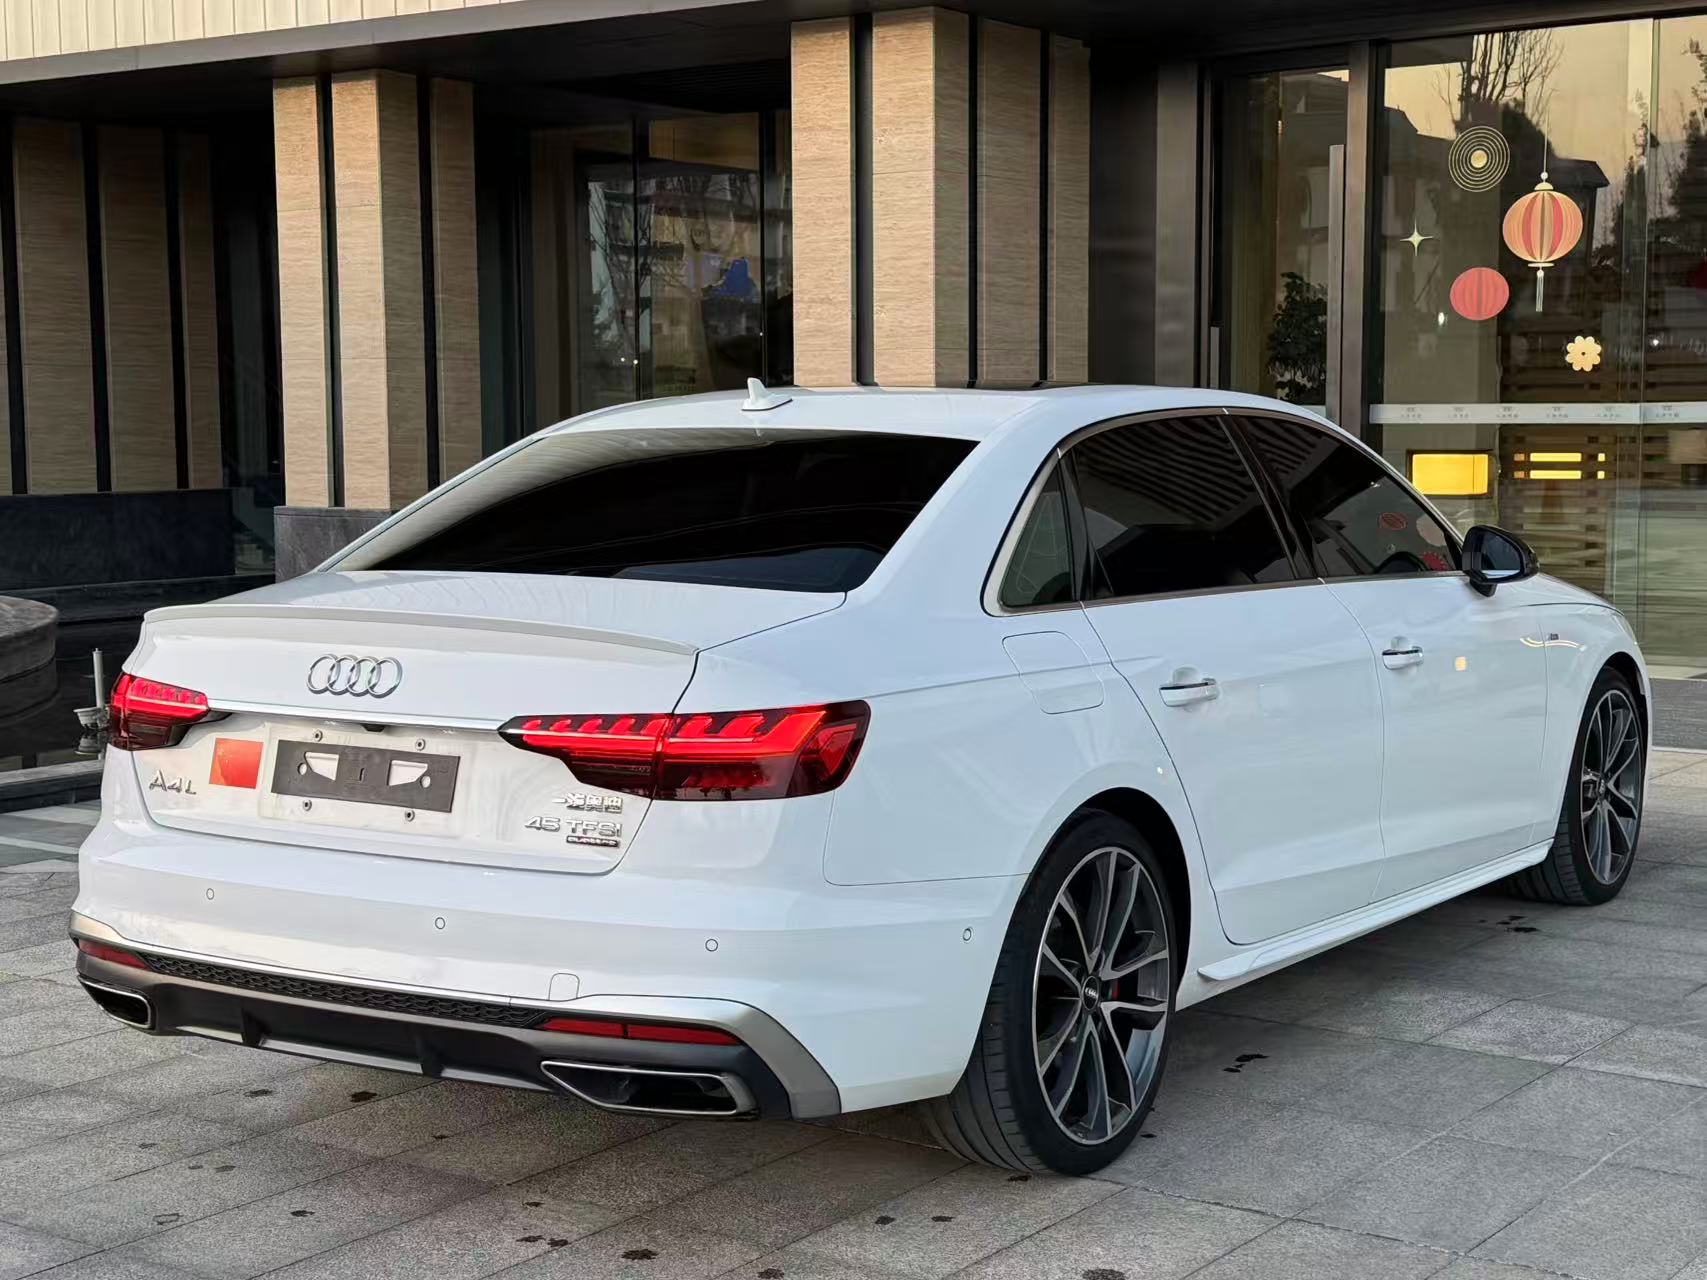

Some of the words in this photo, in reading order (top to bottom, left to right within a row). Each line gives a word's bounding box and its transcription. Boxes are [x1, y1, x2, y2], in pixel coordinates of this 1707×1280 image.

[149, 769, 197, 795] A4L
[525, 815, 561, 832] 45
[566, 819, 622, 837] TFSI
